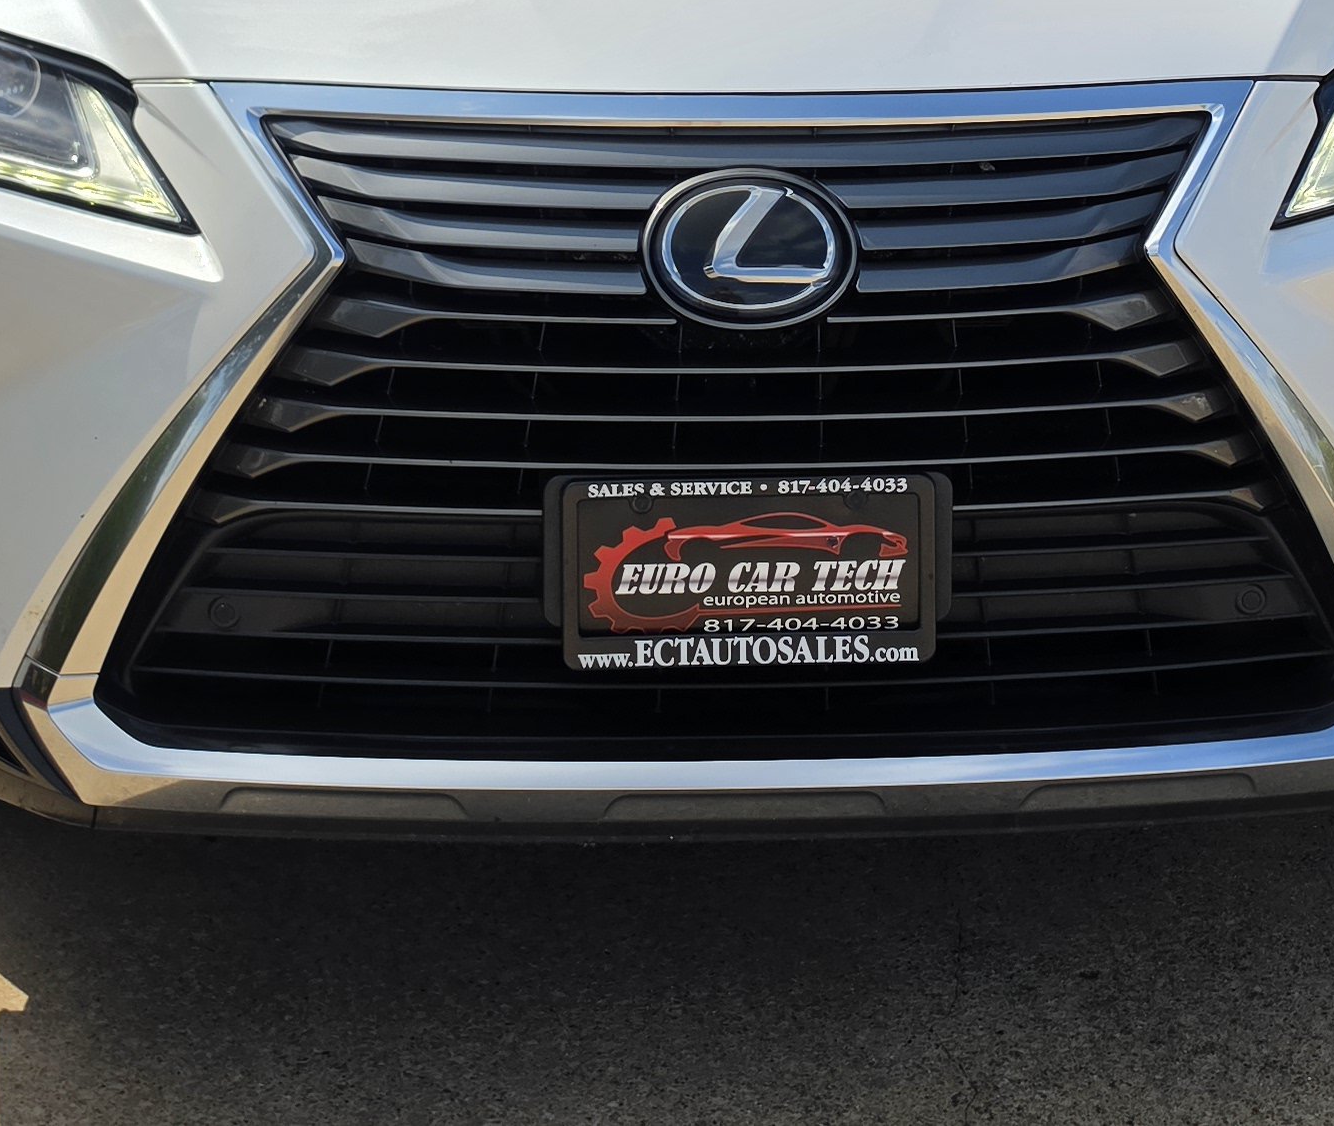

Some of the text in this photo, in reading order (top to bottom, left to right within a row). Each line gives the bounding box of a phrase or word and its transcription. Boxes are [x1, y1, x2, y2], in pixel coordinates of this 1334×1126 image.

[587, 476, 908, 499] SALES & SERVICE 817-404-4033
[615, 559, 907, 595] EURO CAR TECH
[703, 590, 901, 609] european automotive
[703, 616, 899, 633] 817-404-4033
[577, 634, 920, 670] www.ECTAUTOSALES.com
